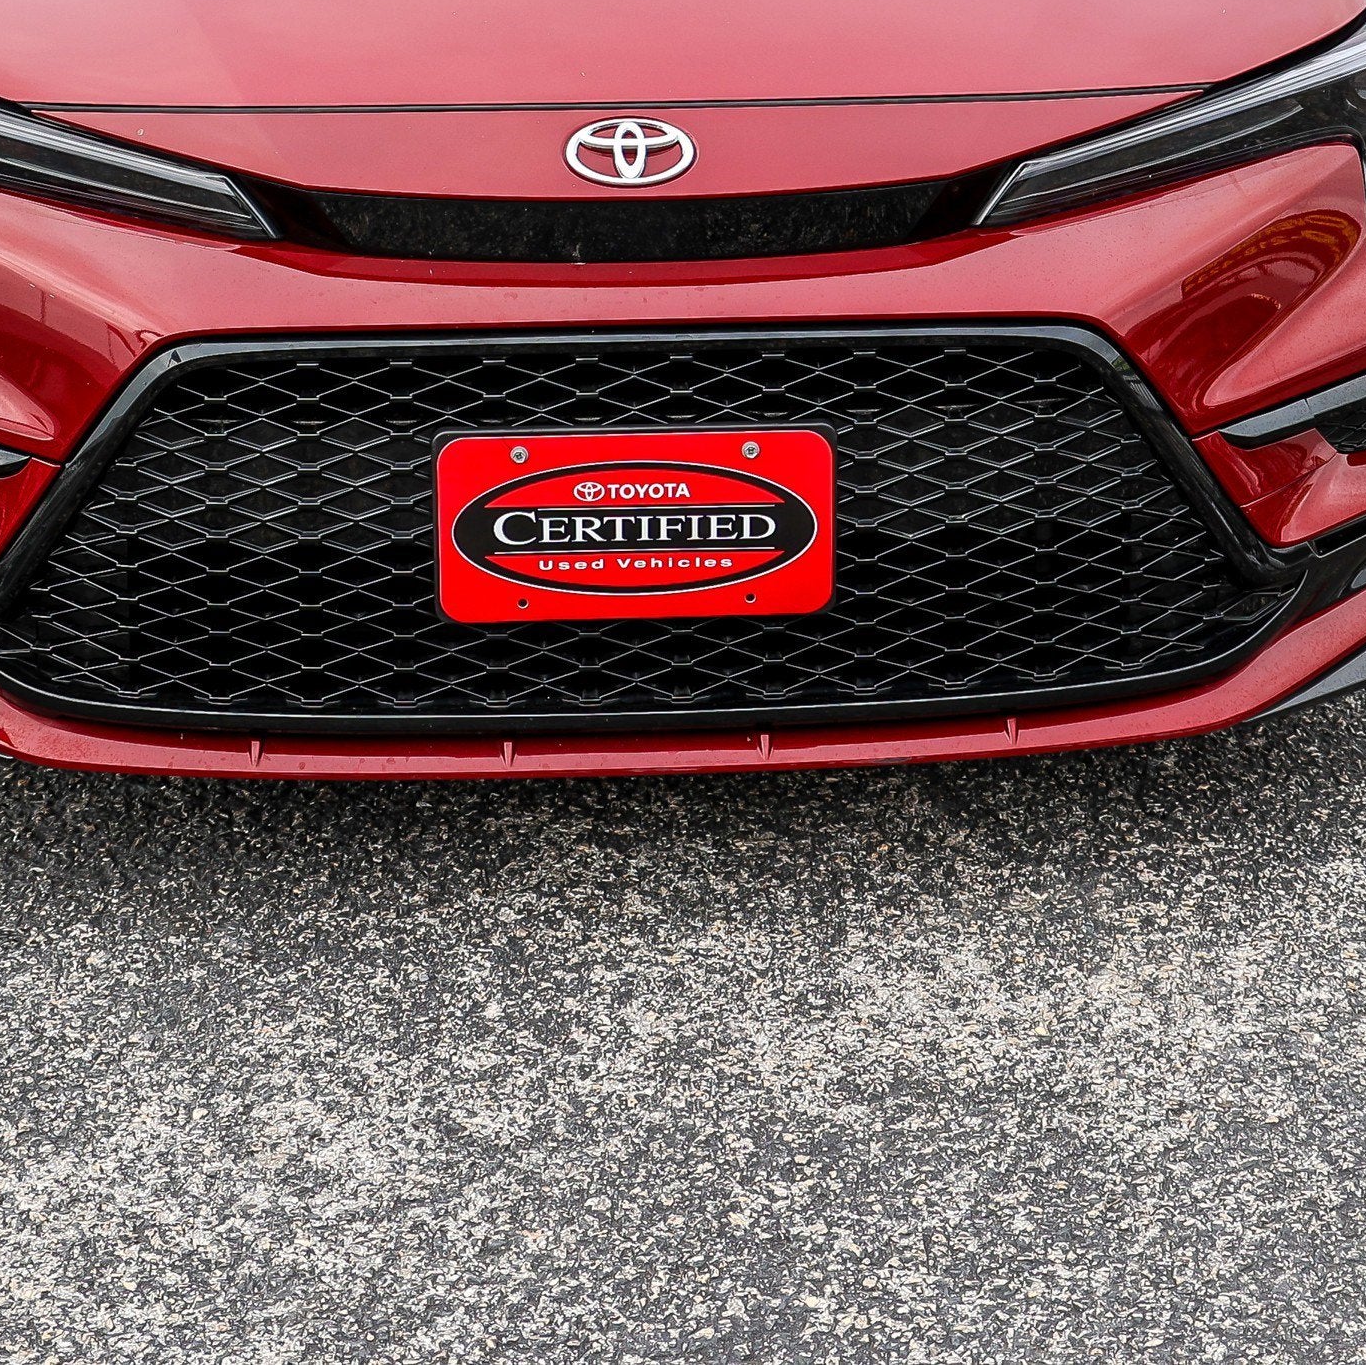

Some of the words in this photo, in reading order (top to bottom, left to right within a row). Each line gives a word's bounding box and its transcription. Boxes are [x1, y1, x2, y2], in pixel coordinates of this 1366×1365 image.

[607, 483, 690, 499] TOYOTA
[493, 511, 777, 546] CERTIFIED
[538, 559, 605, 571] Used
[617, 557, 733, 570] Vehicles
